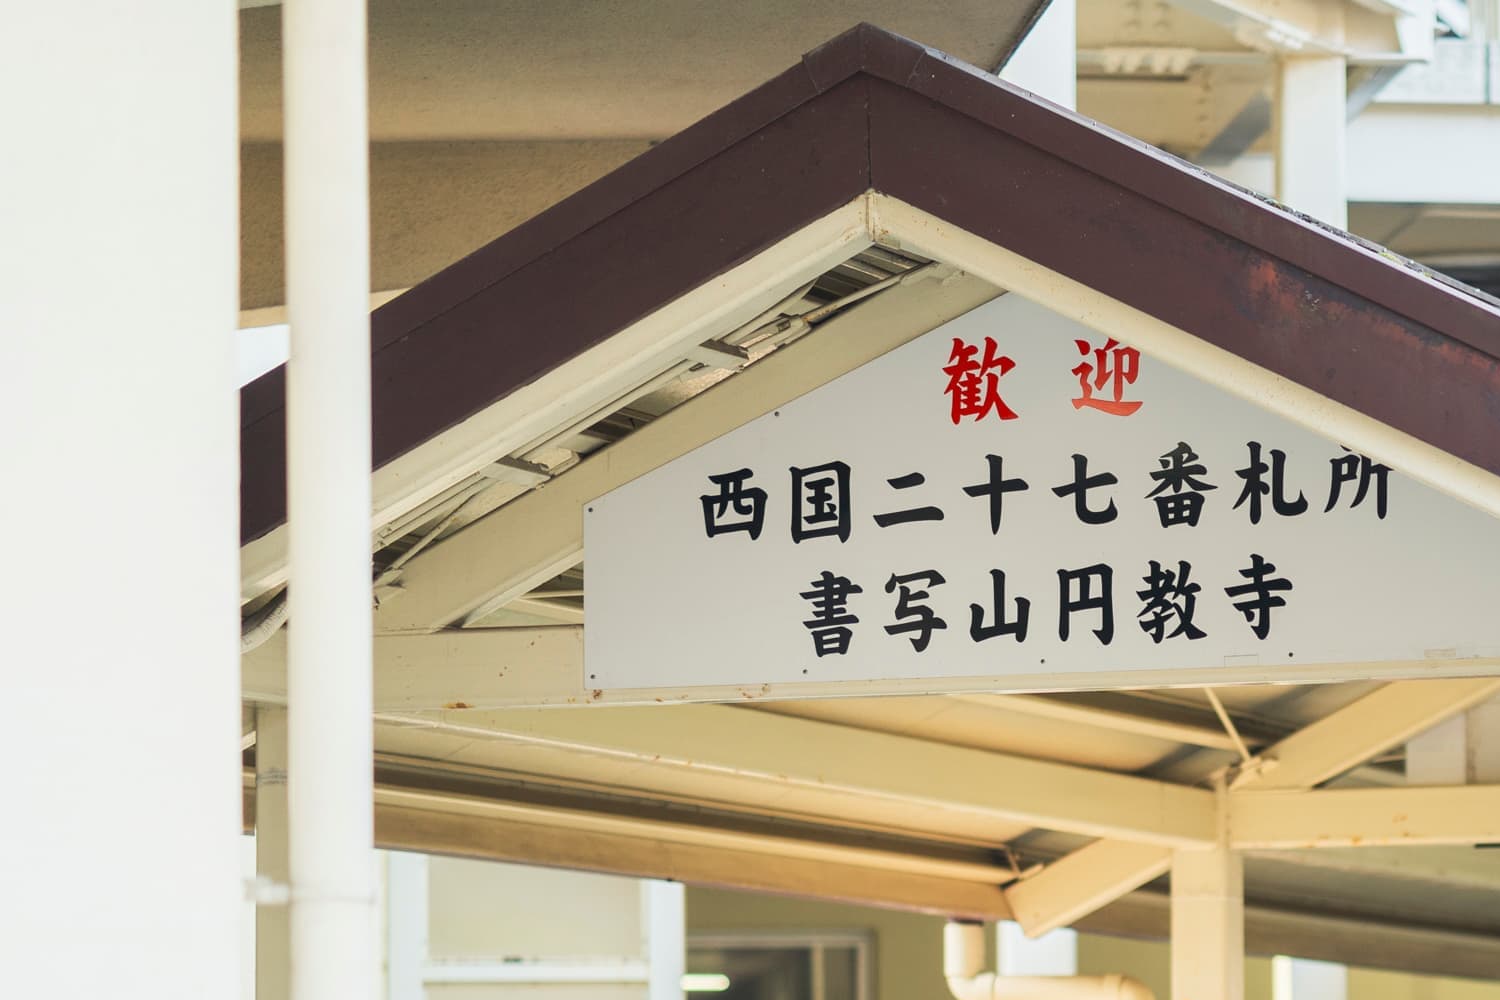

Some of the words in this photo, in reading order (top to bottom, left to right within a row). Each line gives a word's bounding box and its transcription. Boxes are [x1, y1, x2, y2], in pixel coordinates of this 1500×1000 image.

[941, 337, 1144, 425] 歓迎
[699, 441, 1392, 544] 西国二十七番札所
[798, 553, 1294, 659] 書写山円教寺
